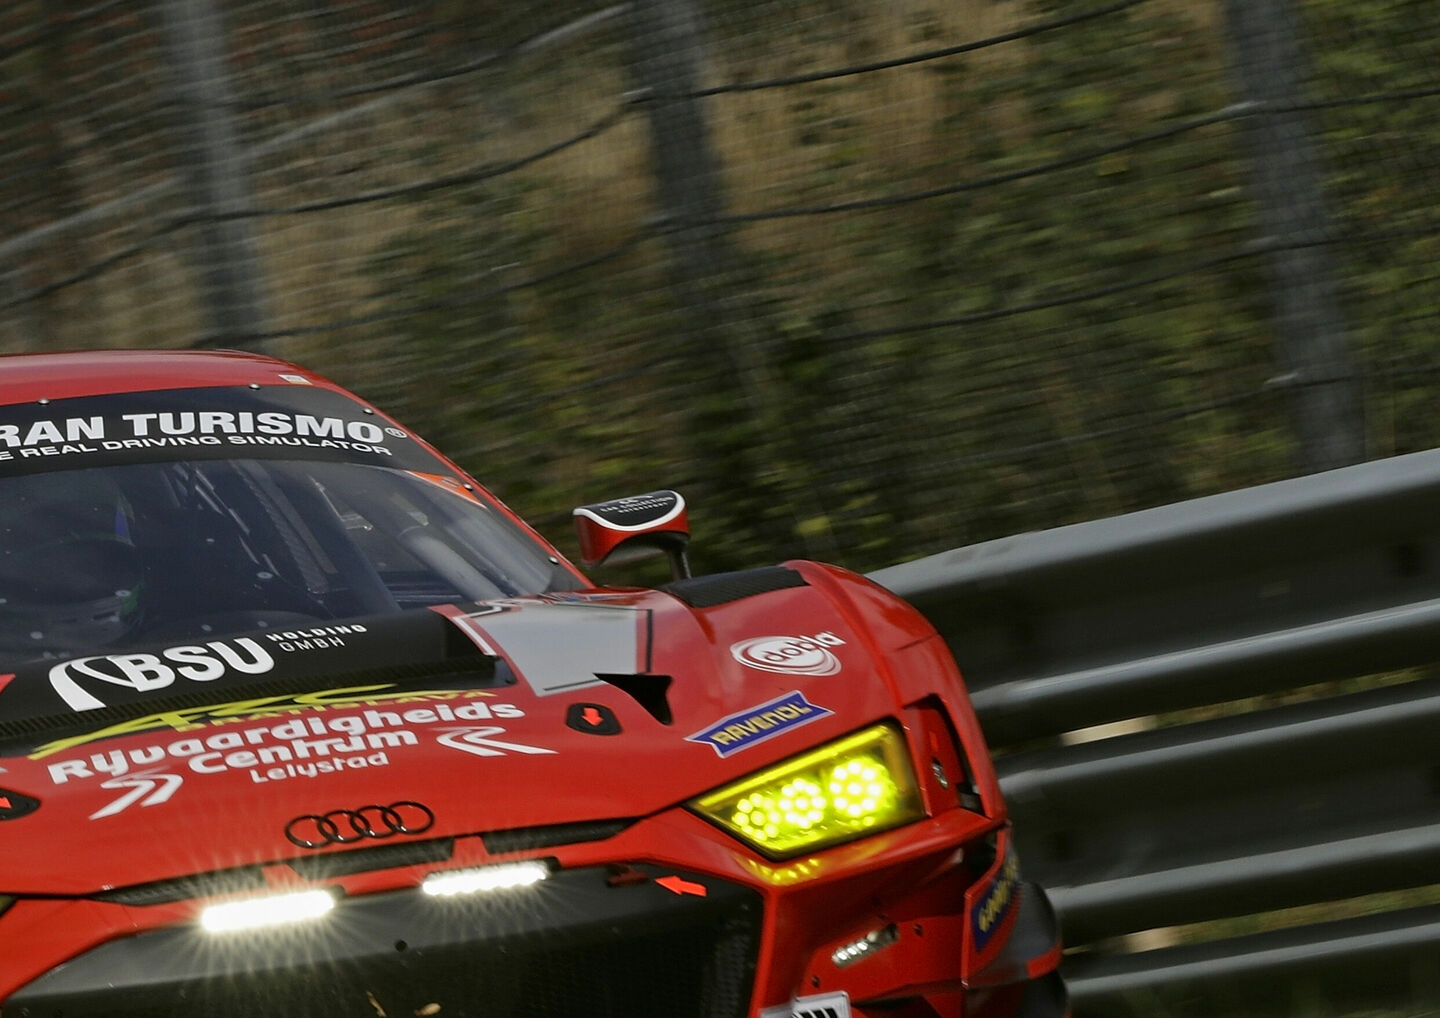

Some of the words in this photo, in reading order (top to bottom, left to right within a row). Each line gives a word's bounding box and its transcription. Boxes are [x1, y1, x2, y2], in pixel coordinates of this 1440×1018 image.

[22, 441, 98, 459] REAL
[101, 435, 222, 452] DRIVING
[227, 434, 393, 457] SIMULATOR
[266, 623, 368, 642] HOLDING
[101, 638, 275, 692] BSU
[710, 702, 812, 746] RAVENOL
[188, 728, 419, 774] Centrum
[249, 752, 390, 784] Lelystad
